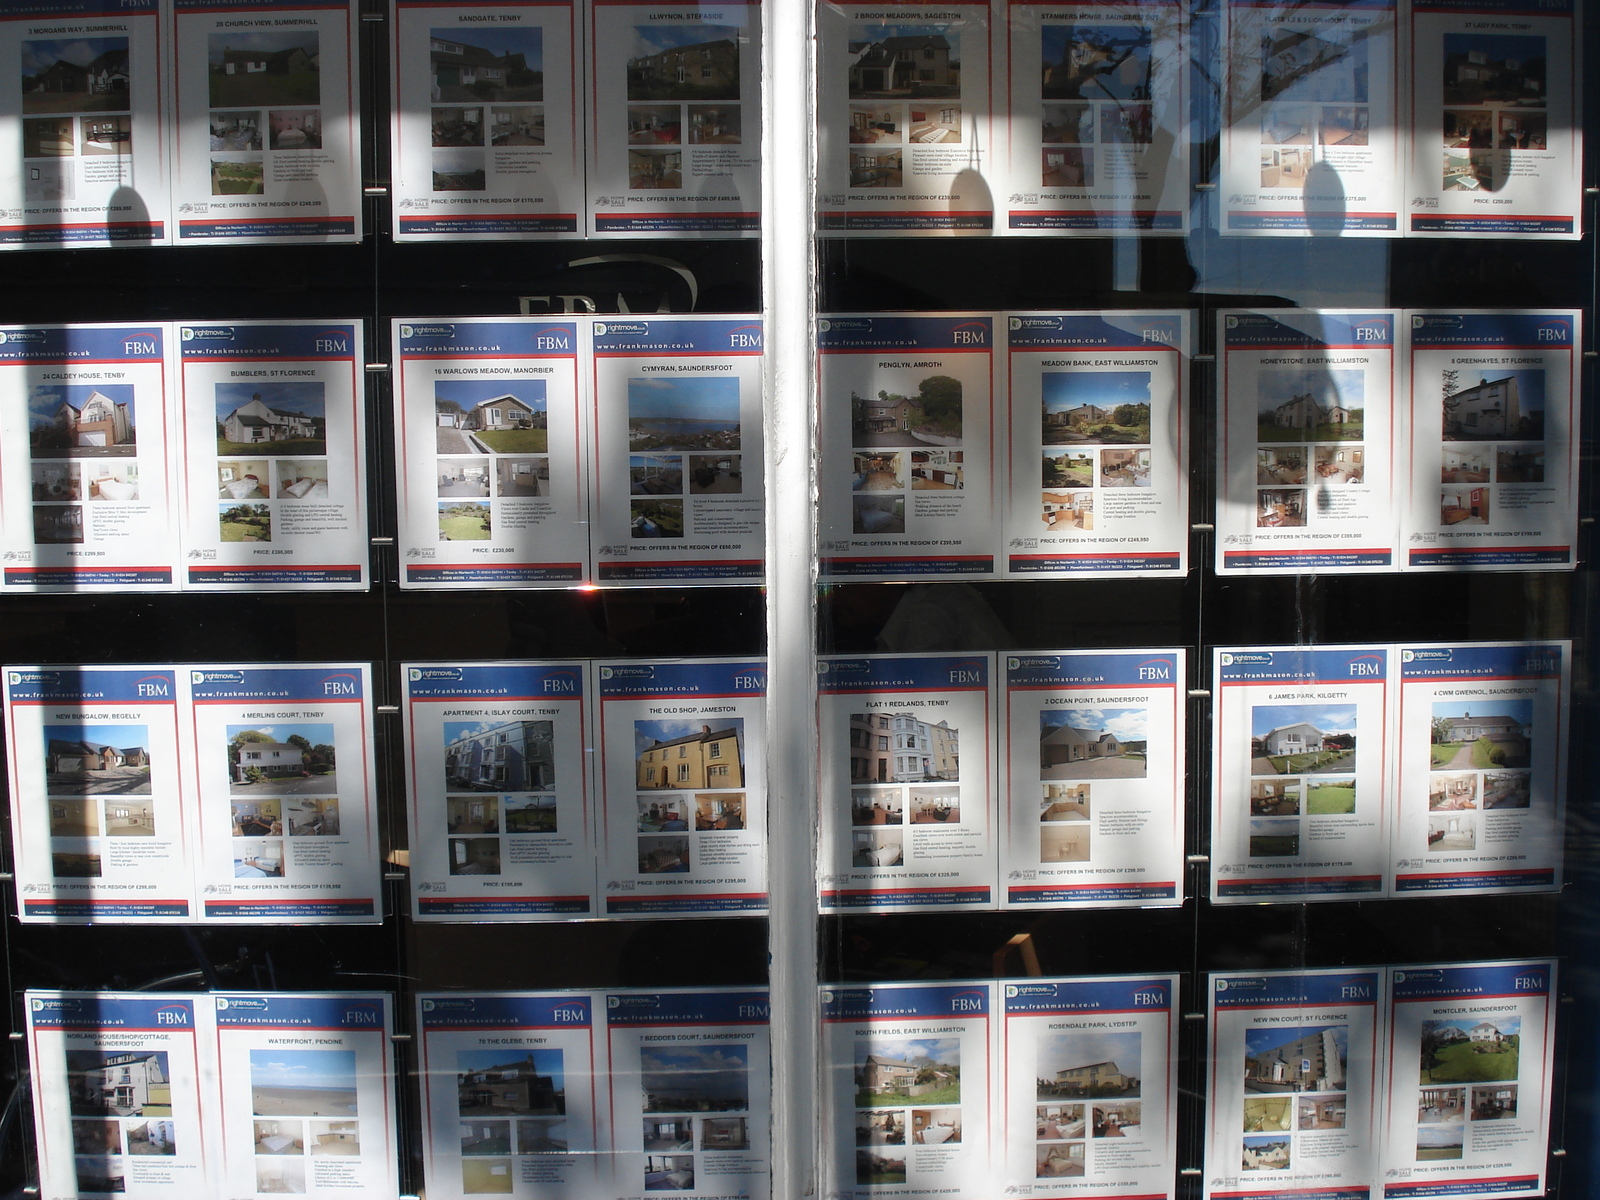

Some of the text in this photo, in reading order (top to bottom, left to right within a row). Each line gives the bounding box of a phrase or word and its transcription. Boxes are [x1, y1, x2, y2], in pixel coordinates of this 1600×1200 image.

[730, 334, 762, 347] FBM
[953, 331, 984, 344] FBM
[1142, 329, 1173, 342] FBM
[1356, 328, 1387, 341] FBM
[1537, 328, 1566, 341] FBM
[124, 342, 156, 355] FBM
[315, 339, 347, 352] FBM
[536, 337, 569, 349] FBM
[1139, 667, 1170, 680] FBM
[1349, 663, 1380, 676] FBM
[734, 677, 766, 689] FBM
[950, 670, 980, 683] FBM
[138, 684, 168, 697] FBM
[324, 682, 355, 695] FBM
[543, 679, 574, 692] FBM
[1515, 977, 1542, 989] FBM
[1341, 986, 1370, 998] FBM
[952, 999, 982, 1011] FBM
[1134, 993, 1163, 1005] FBM
[1008, 1002, 1100, 1010] www.frankmason.co.uk
[157, 1012, 187, 1024] FBM
[346, 1011, 376, 1024] FBM
[554, 1009, 584, 1022] FBM
